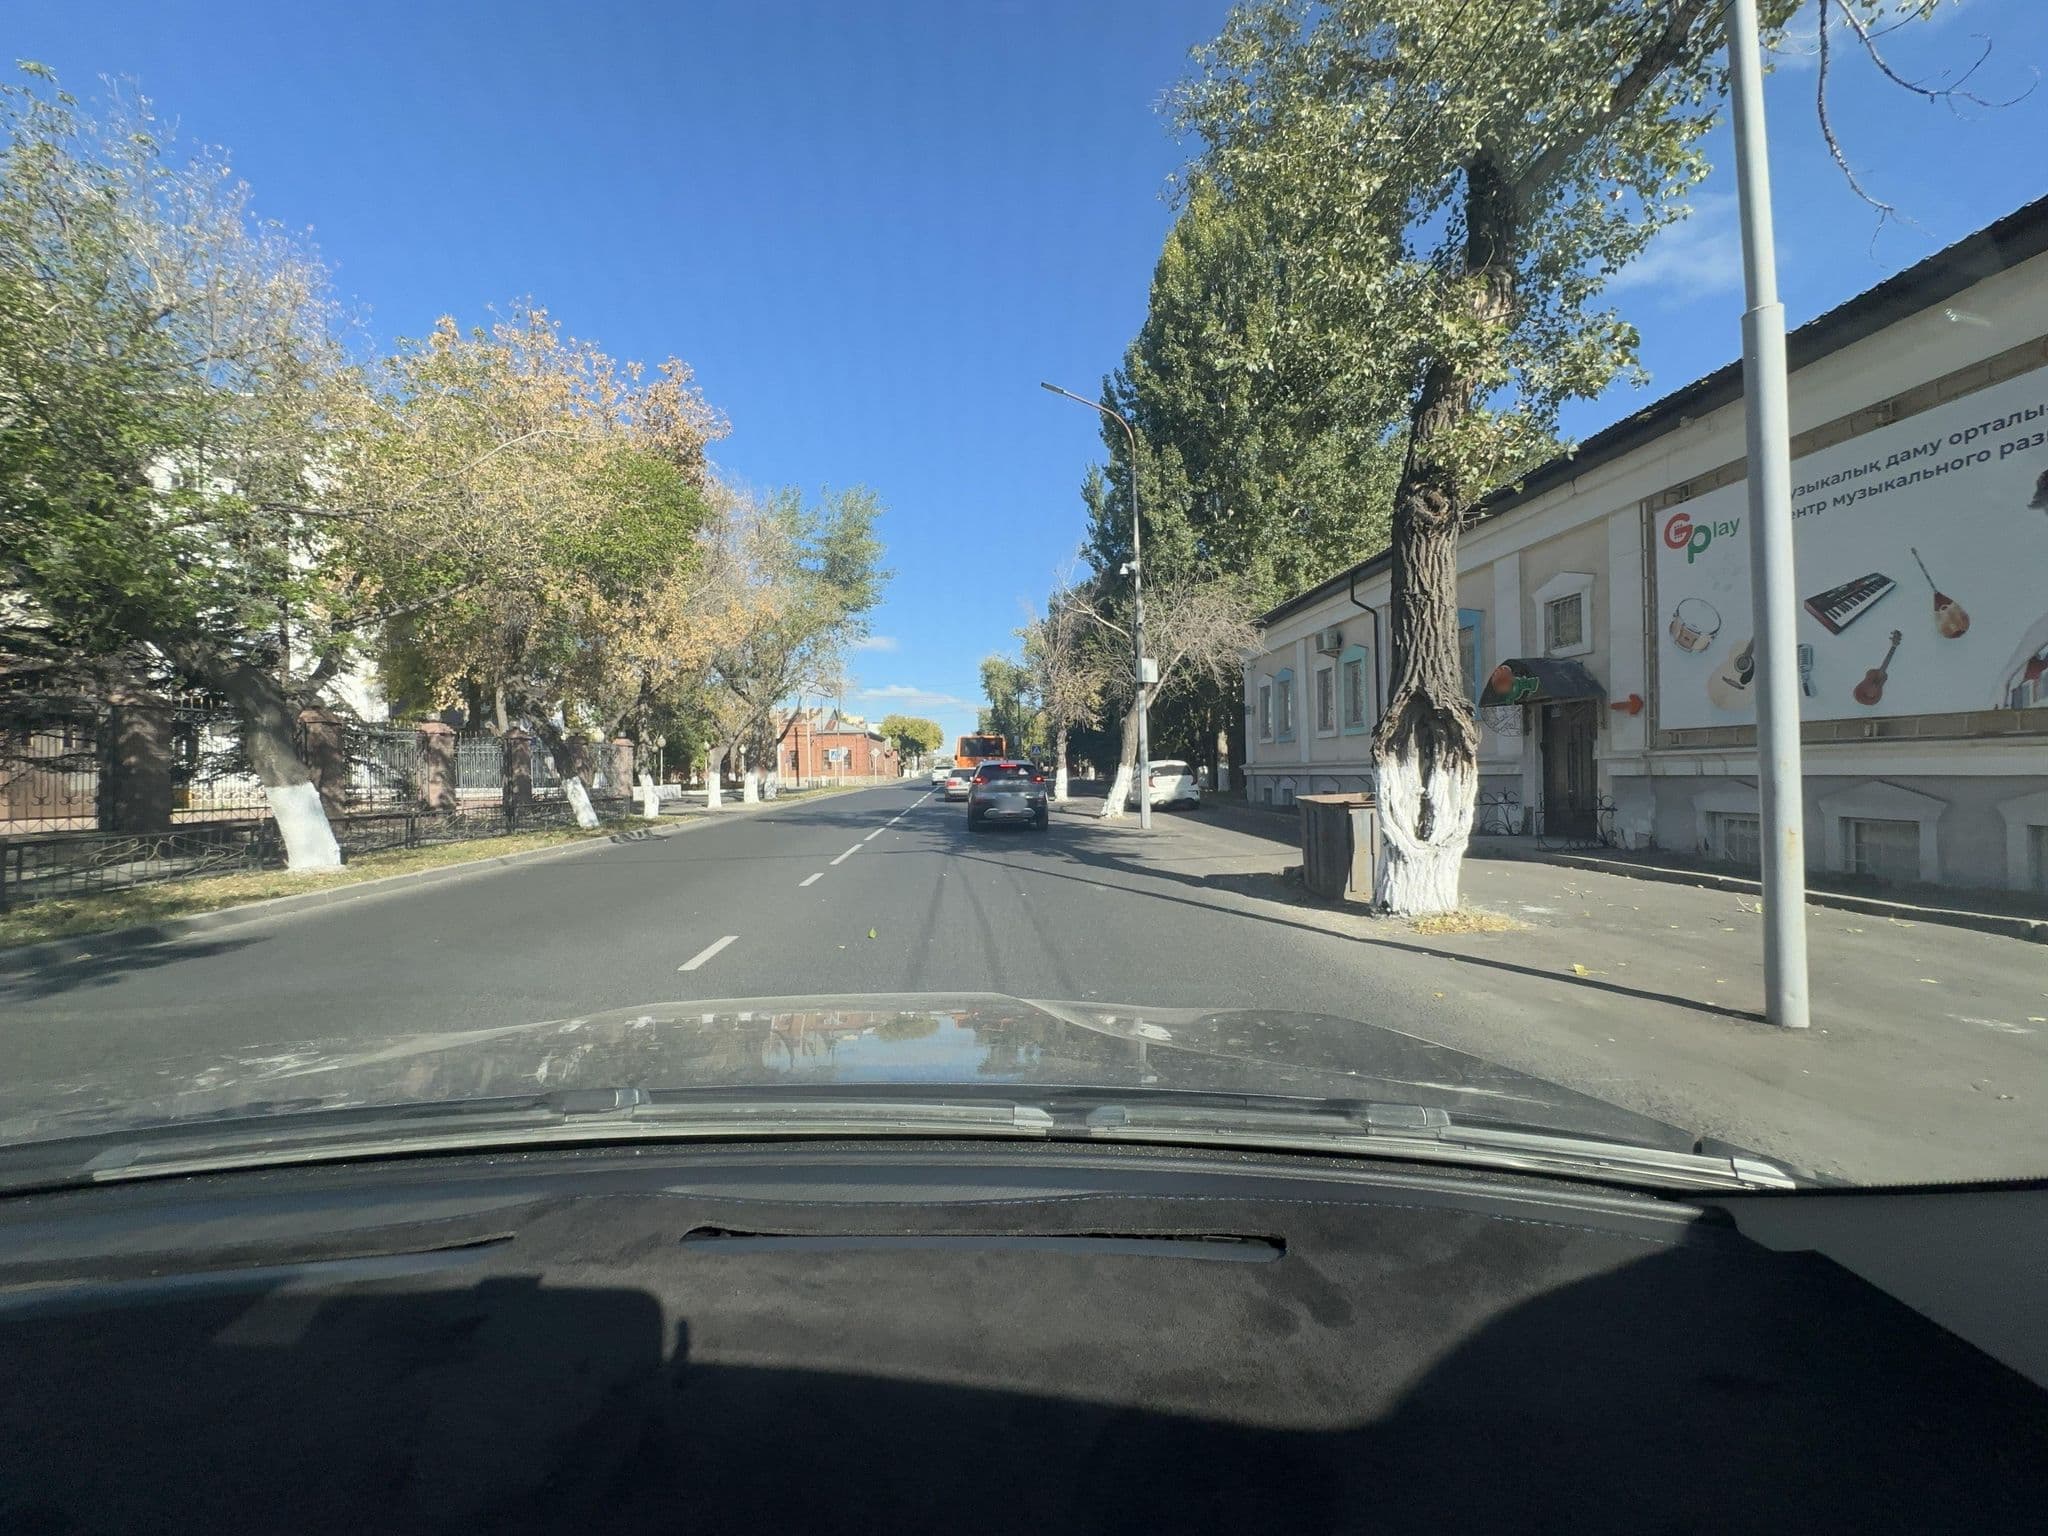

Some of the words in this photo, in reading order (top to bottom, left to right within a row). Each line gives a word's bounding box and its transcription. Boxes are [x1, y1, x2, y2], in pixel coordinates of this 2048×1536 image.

[1791, 459, 1882, 500] узыкалық
[1885, 438, 1943, 470] даму
[1948, 403, 2048, 445] орталы
[1831, 449, 1991, 507] музыкального
[1999, 430, 2048, 460] раз
